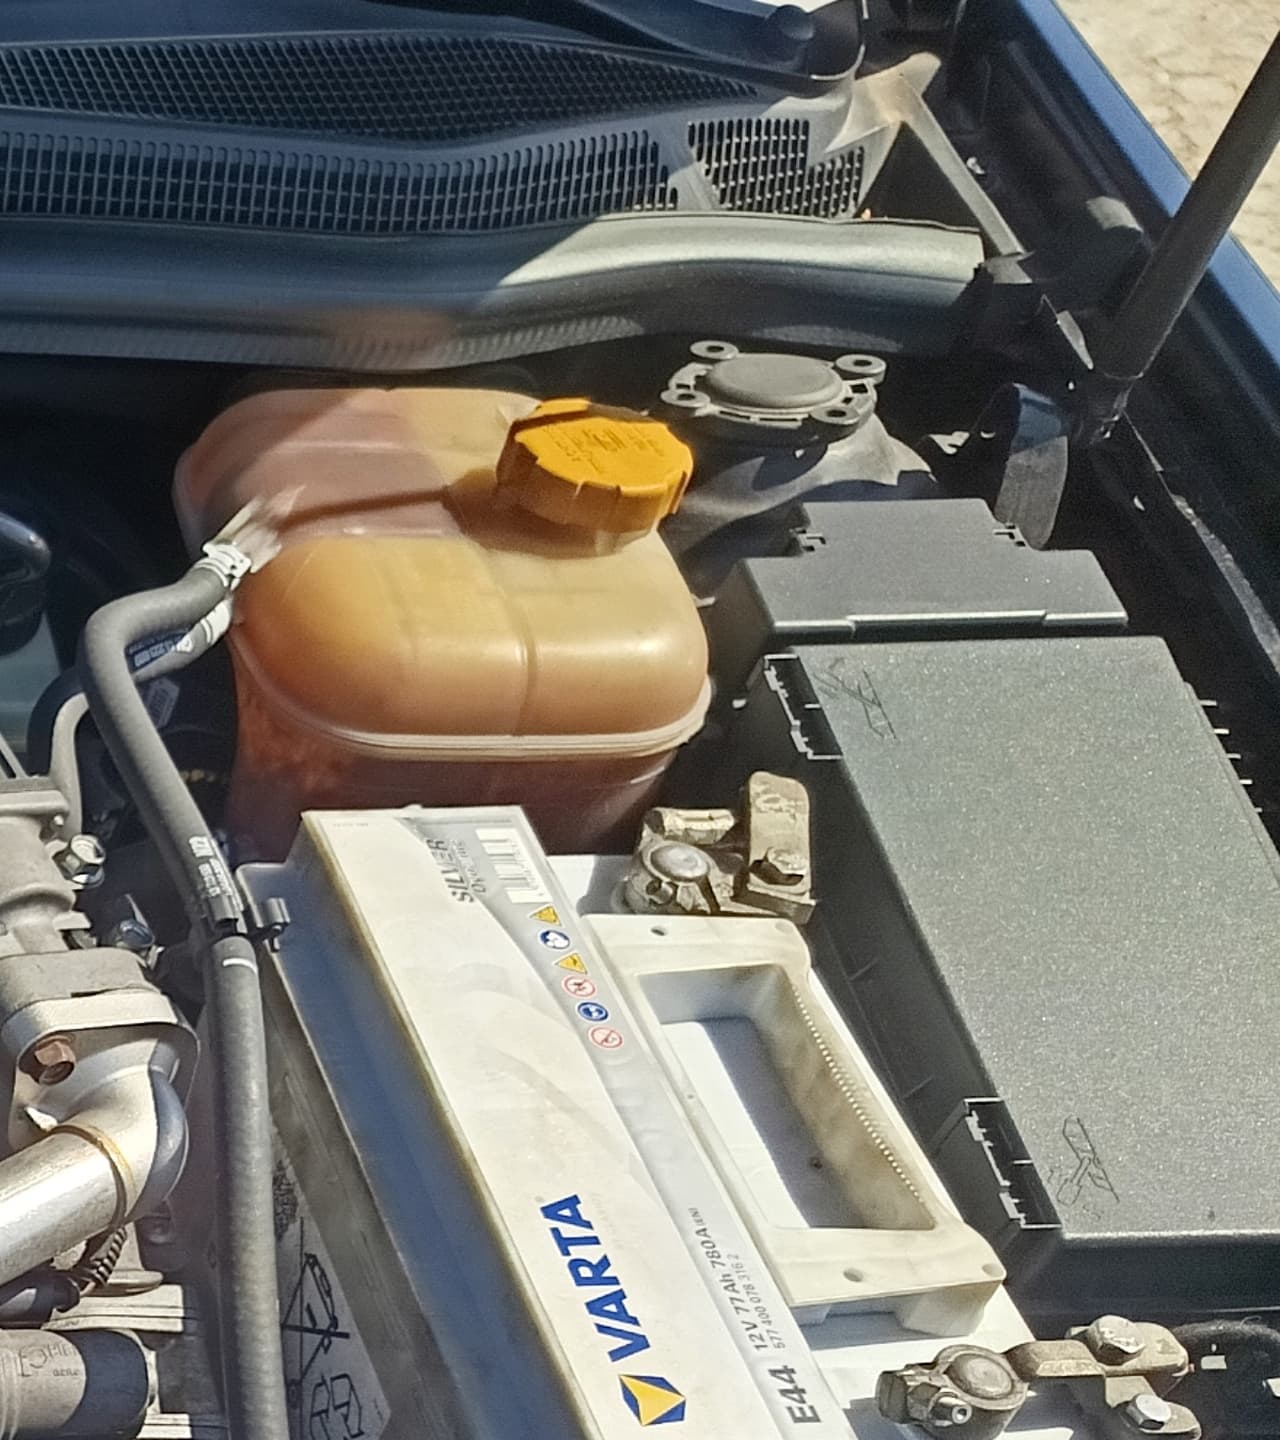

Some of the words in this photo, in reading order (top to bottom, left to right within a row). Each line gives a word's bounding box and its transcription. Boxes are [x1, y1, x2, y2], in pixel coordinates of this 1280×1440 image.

[426, 839, 474, 903] SILVER
[540, 1194, 651, 1362] VARTA
[719, 1273, 750, 1315] 77Ah
[742, 1283, 762, 1304] 078
[754, 1306, 772, 1326] 400
[741, 1320, 768, 1351] 12V
[767, 1329, 786, 1350] 577
[768, 1364, 821, 1424] E44
